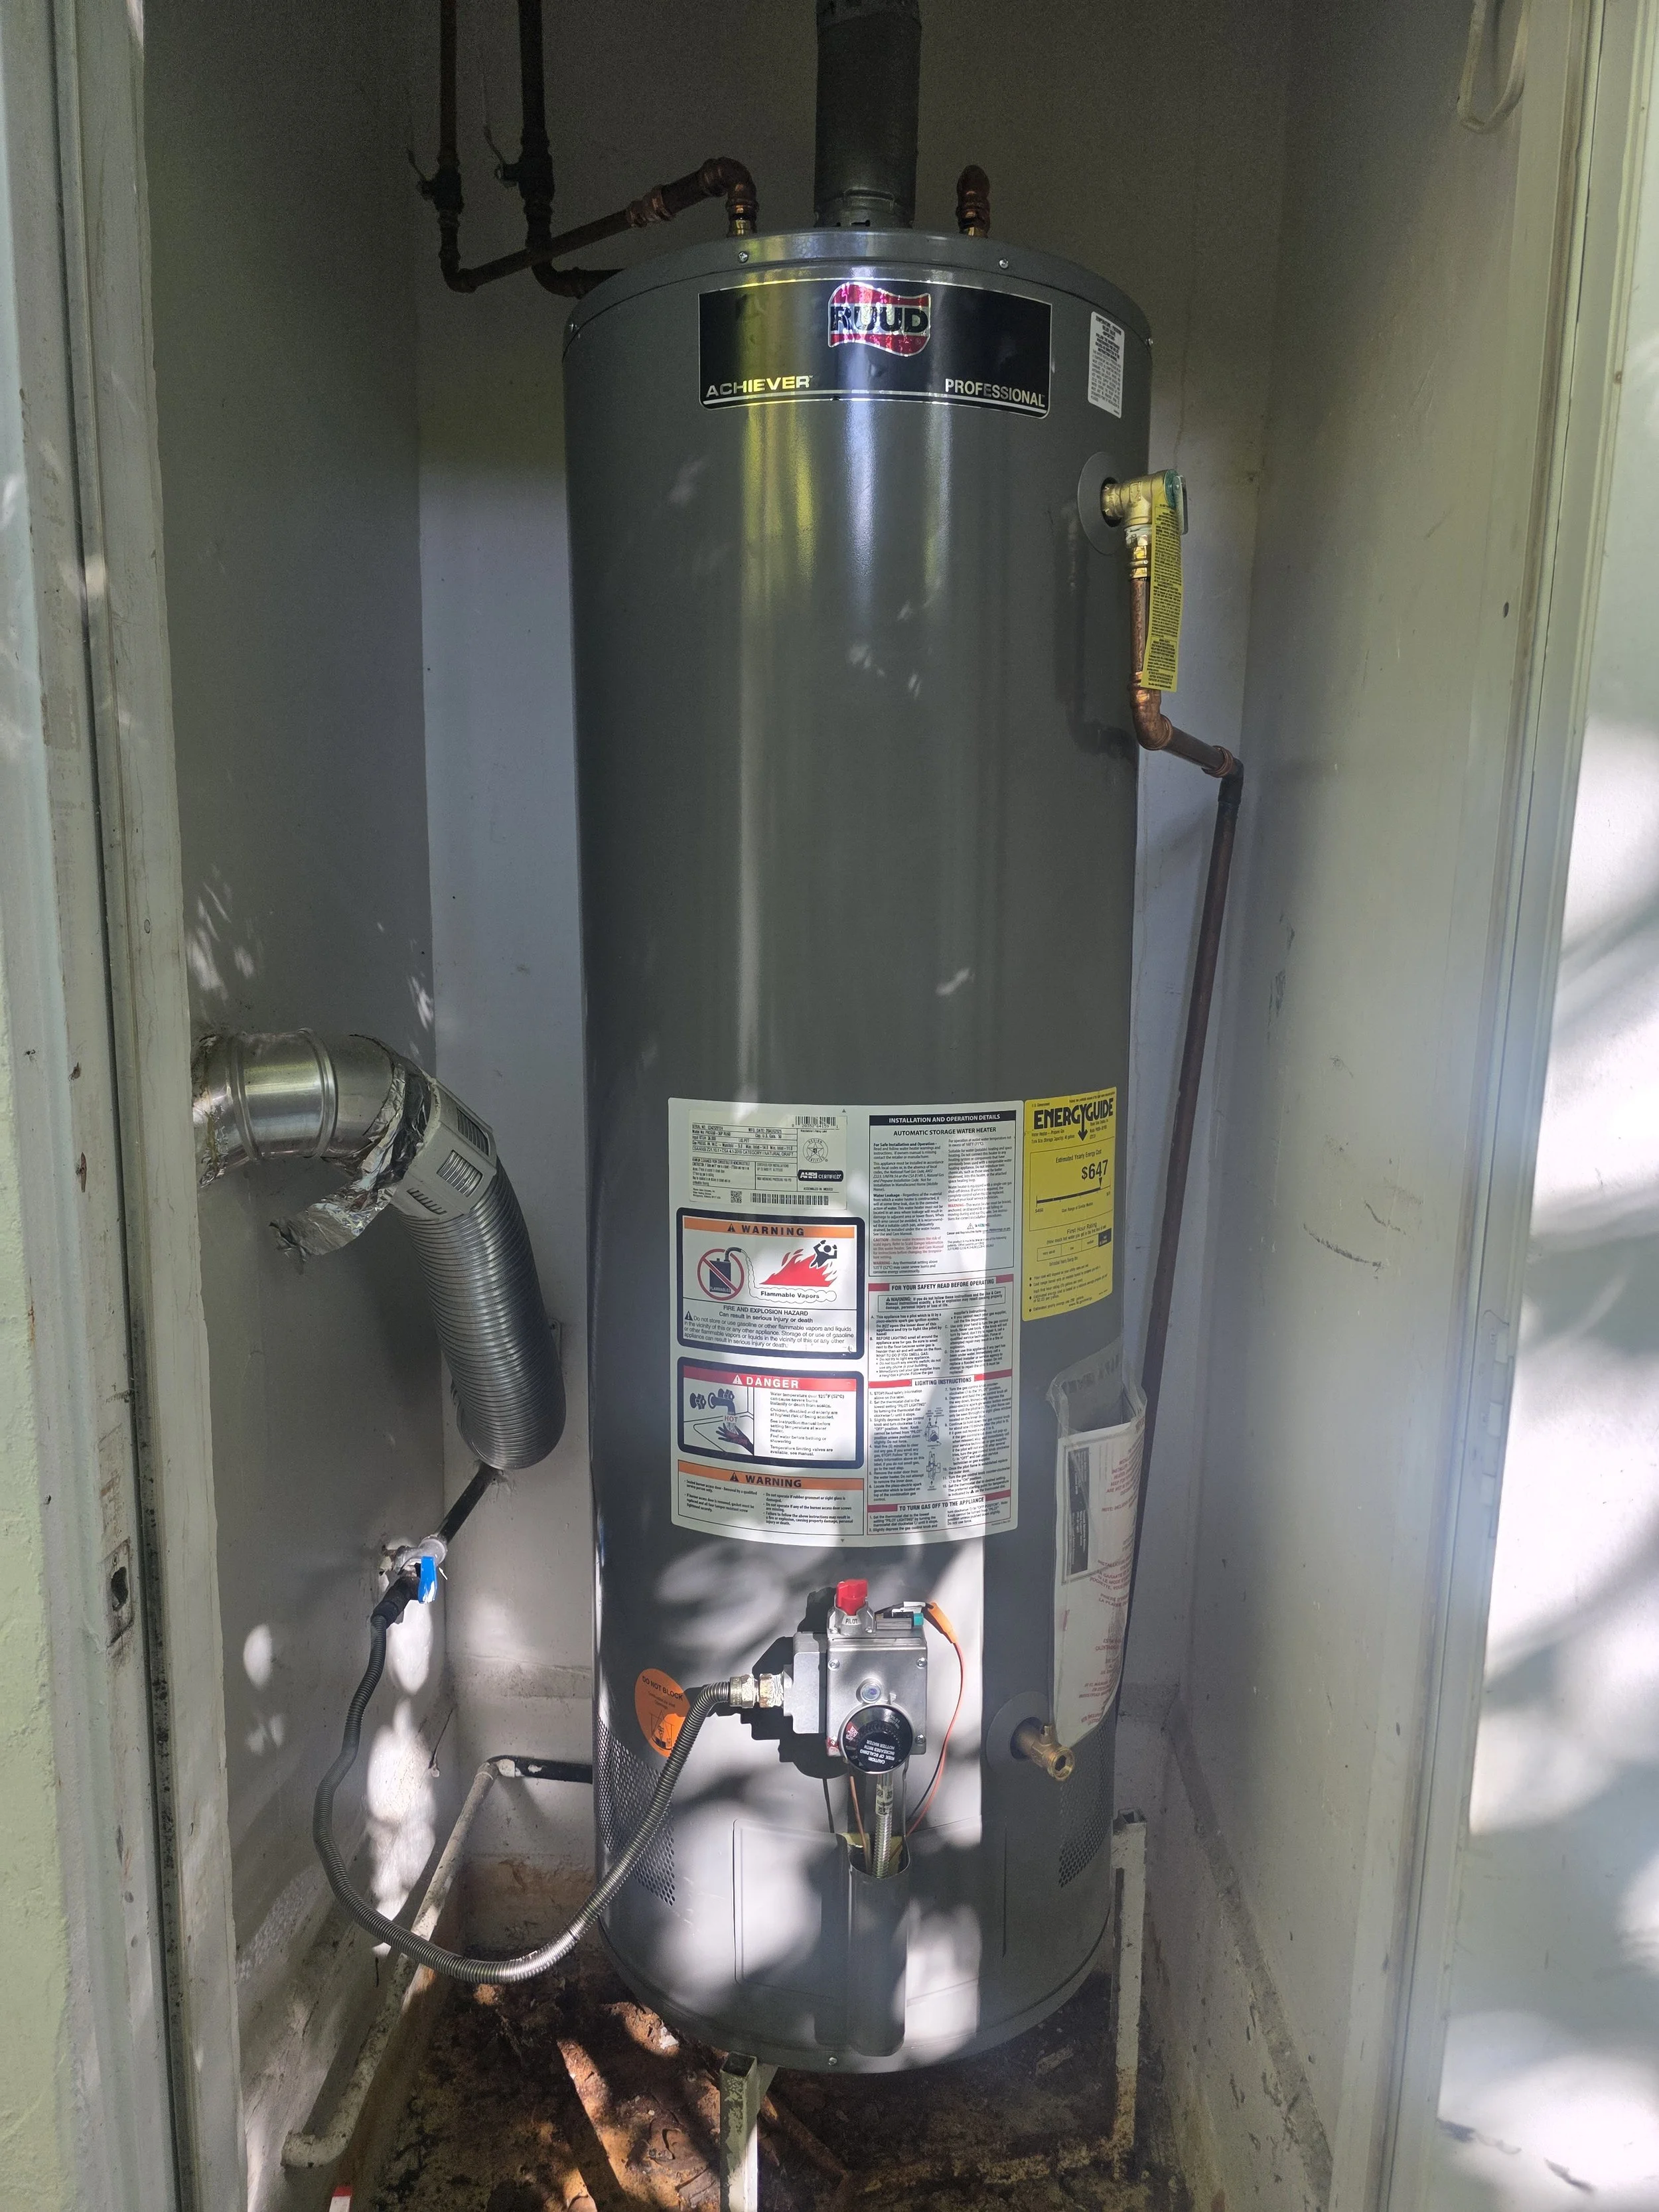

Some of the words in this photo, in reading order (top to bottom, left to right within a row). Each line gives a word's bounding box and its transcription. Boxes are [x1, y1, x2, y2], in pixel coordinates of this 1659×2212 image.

[830, 305, 928, 333] RUUD
[705, 375, 810, 398] ACHIEVER
[945, 378, 1046, 408] PROFESSIONAL
[1034, 1098, 1114, 1130] ENERGYGUIDE
[1081, 1159, 1108, 1181] $647
[741, 1224, 804, 1236] WARNING
[746, 1376, 799, 1389] DANGER
[745, 1475, 802, 1488] WARNING
[959, 1497, 984, 1506] APPLIANCE
[642, 1676, 650, 1685] DO
[651, 1680, 662, 1692] NOT
[662, 1687, 684, 1701] BLOCK
